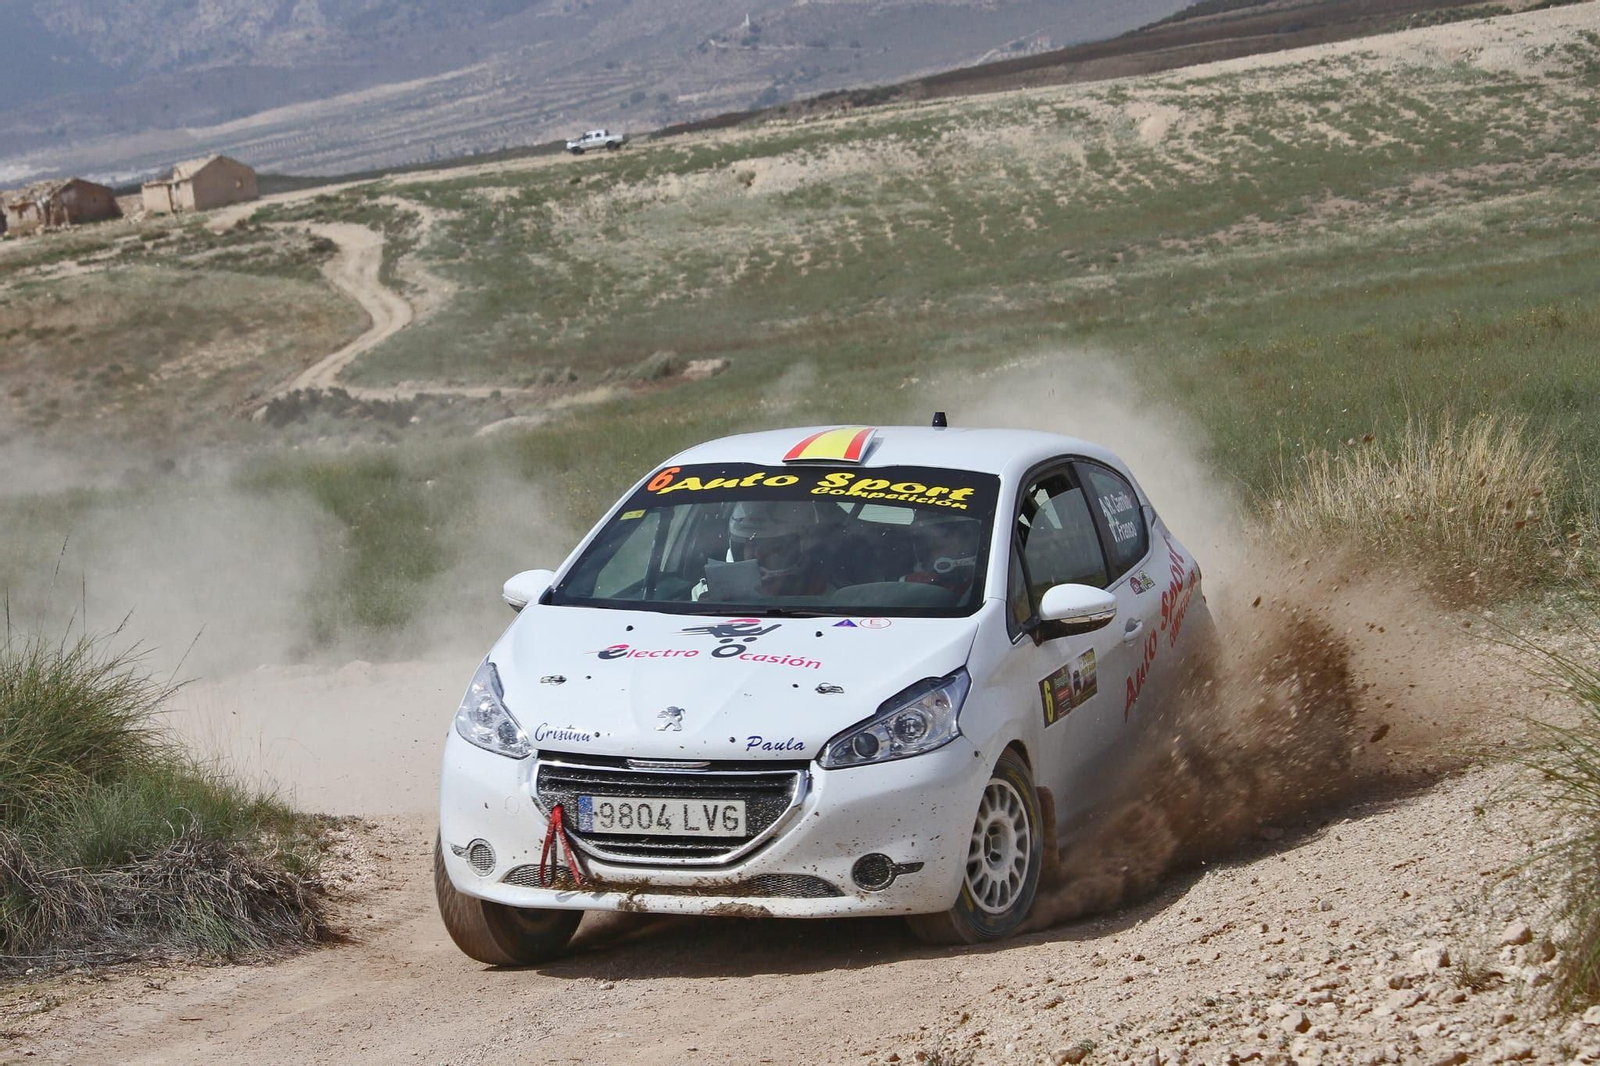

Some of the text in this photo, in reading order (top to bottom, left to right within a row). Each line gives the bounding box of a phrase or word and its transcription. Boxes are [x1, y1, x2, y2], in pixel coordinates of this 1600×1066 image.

[647, 466, 681, 491] 6
[656, 472, 975, 501] Auto Sport
[810, 486, 969, 510] Competición
[711, 643, 822, 670] Ocasión
[1043, 680, 1054, 723] 6
[745, 735, 806, 752] Paula
[599, 802, 672, 831] 9804
[683, 803, 740, 832] LVG
